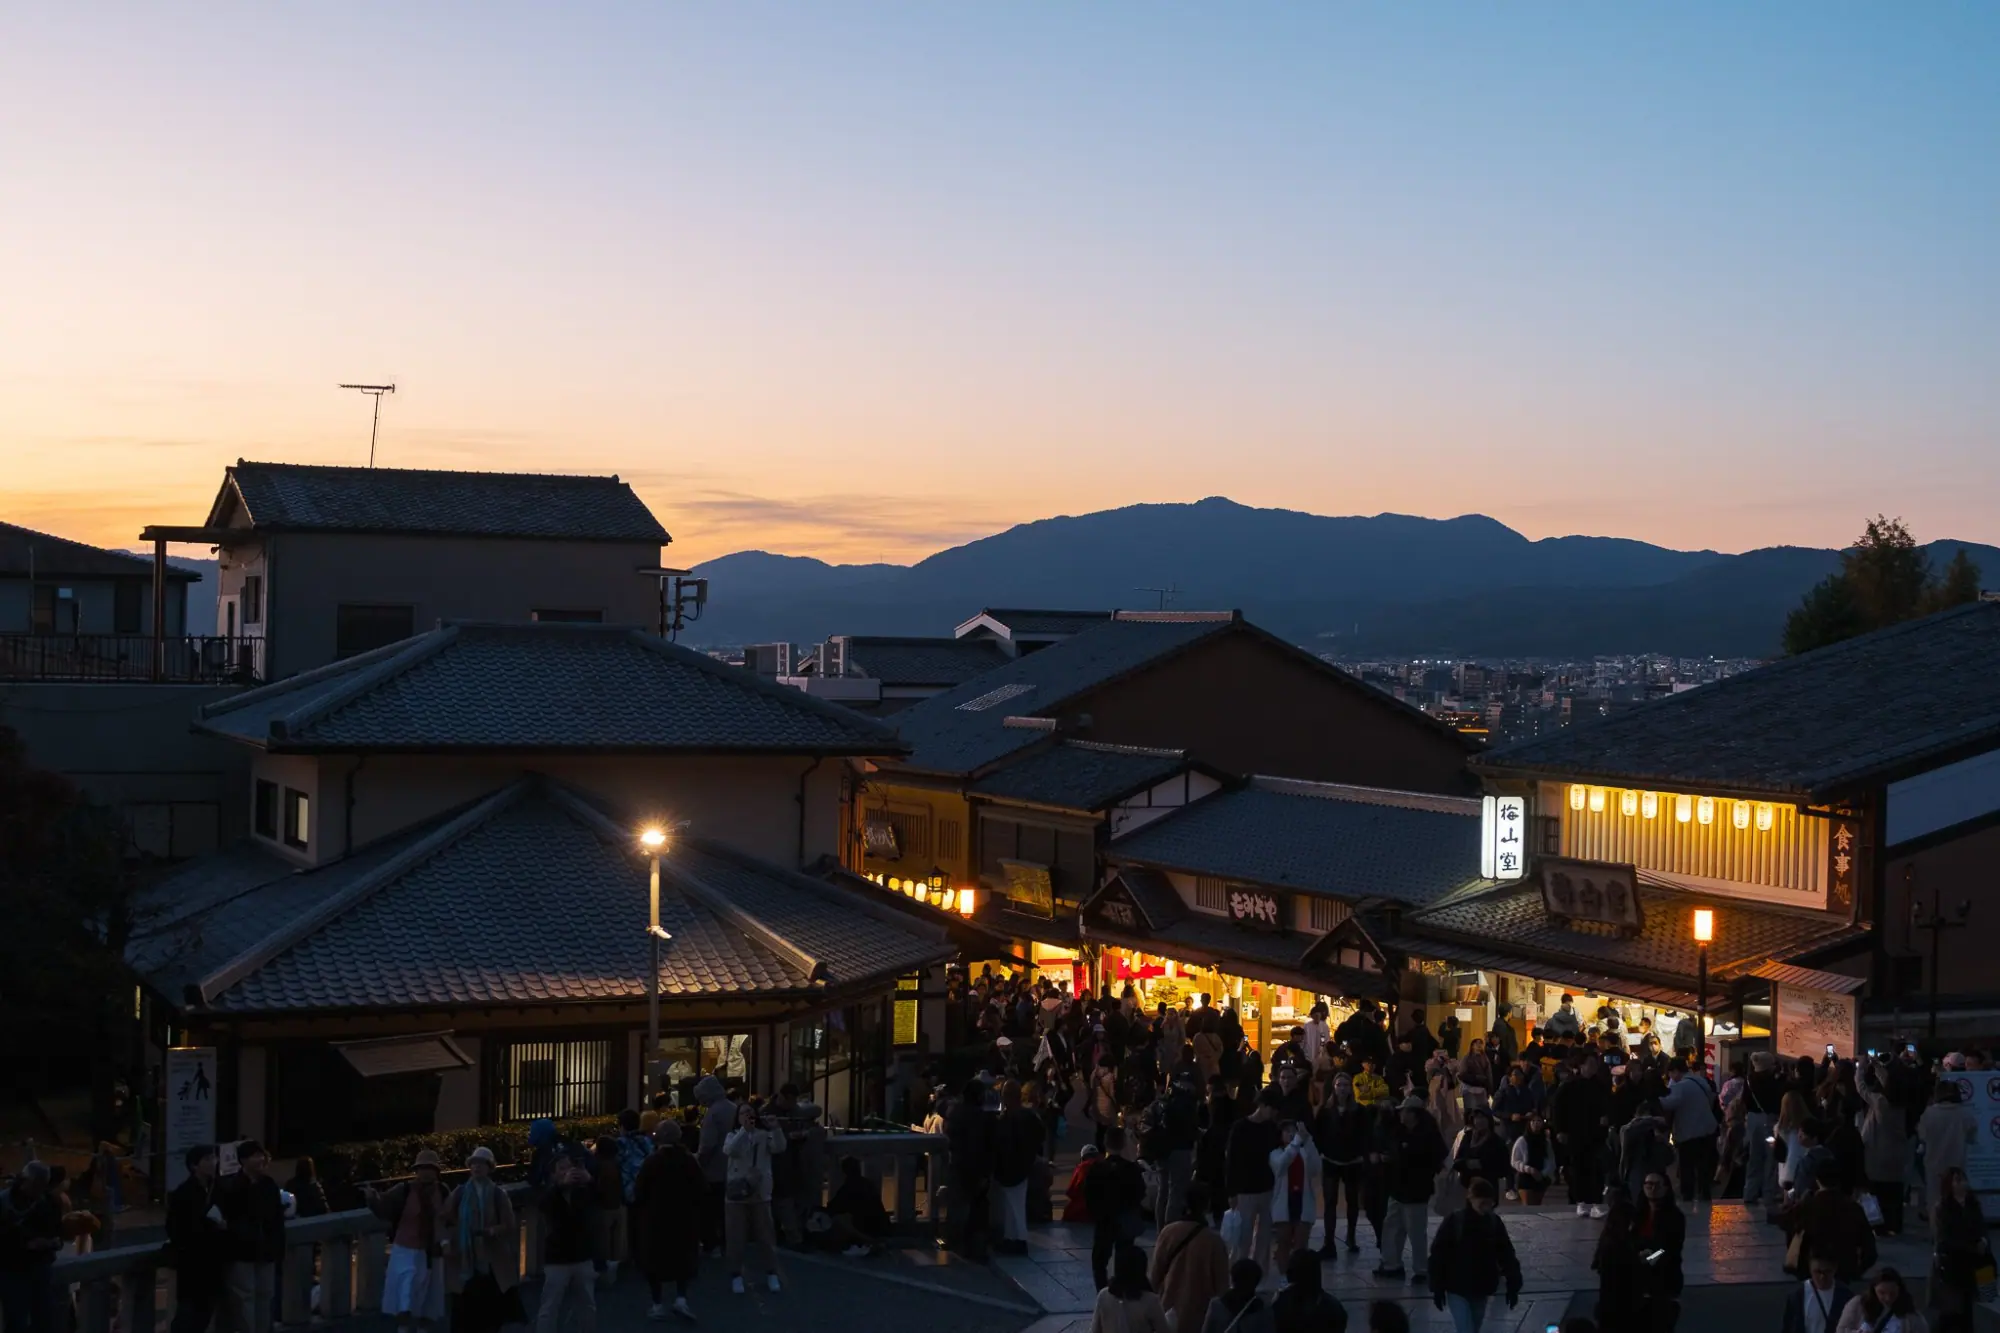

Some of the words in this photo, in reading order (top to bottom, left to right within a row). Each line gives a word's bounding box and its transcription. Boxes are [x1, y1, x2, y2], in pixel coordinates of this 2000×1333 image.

[1500, 804, 1519, 871] 梅山堂
[1833, 808, 1854, 904] 食事処
